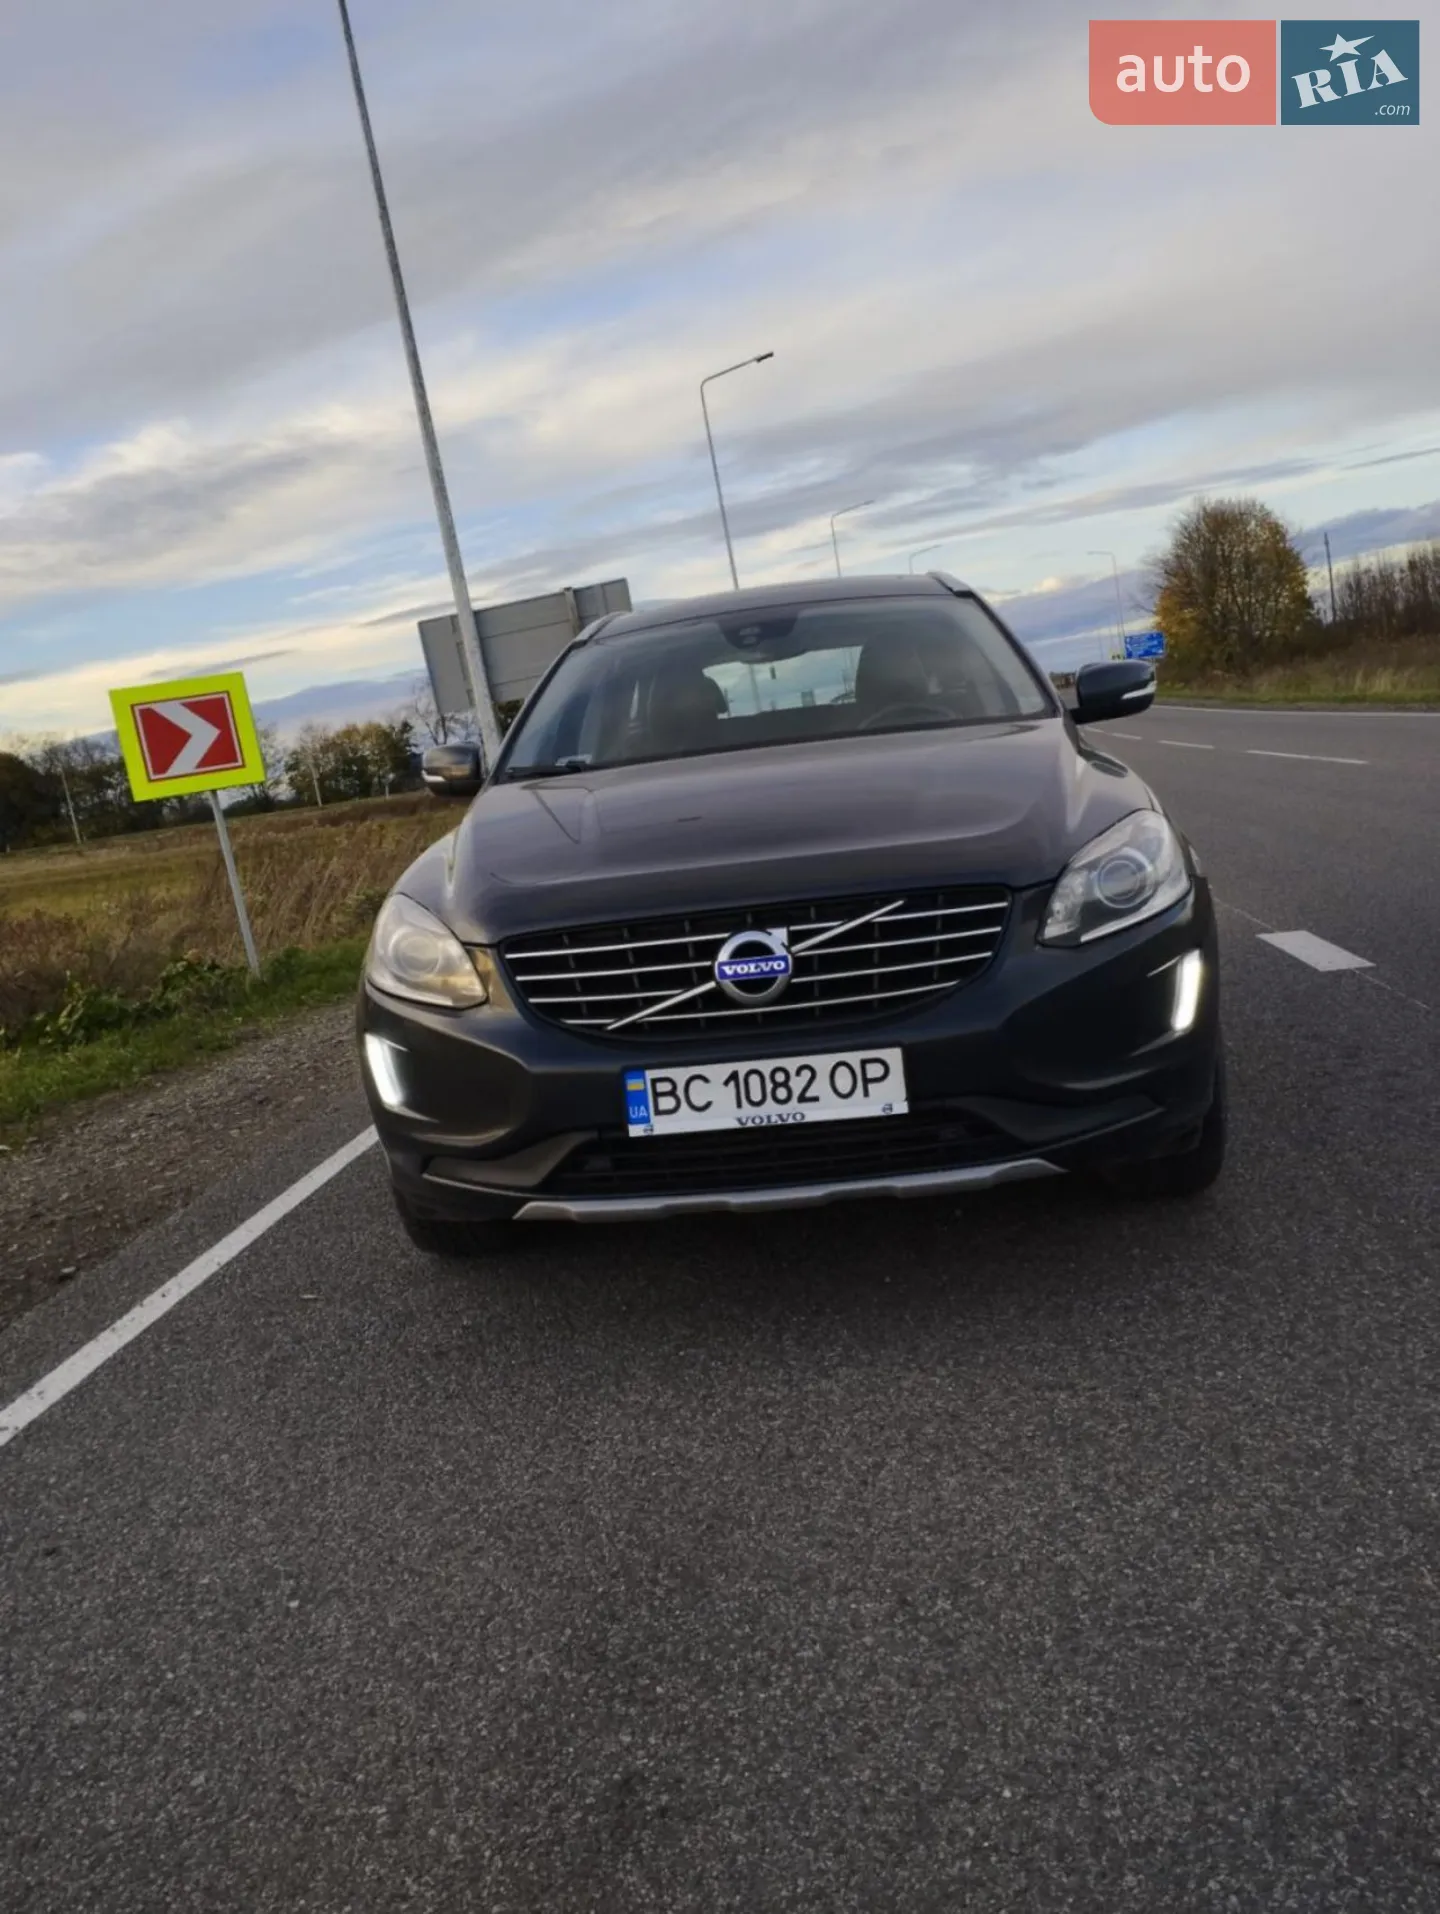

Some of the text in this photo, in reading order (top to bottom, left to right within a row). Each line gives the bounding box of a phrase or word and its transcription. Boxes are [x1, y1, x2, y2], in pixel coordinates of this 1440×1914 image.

[722, 960, 786, 976] VOLVO
[650, 1057, 890, 1116] BC 1082 OP
[629, 1105, 648, 1118] UA
[735, 1111, 806, 1126] VOLVO
